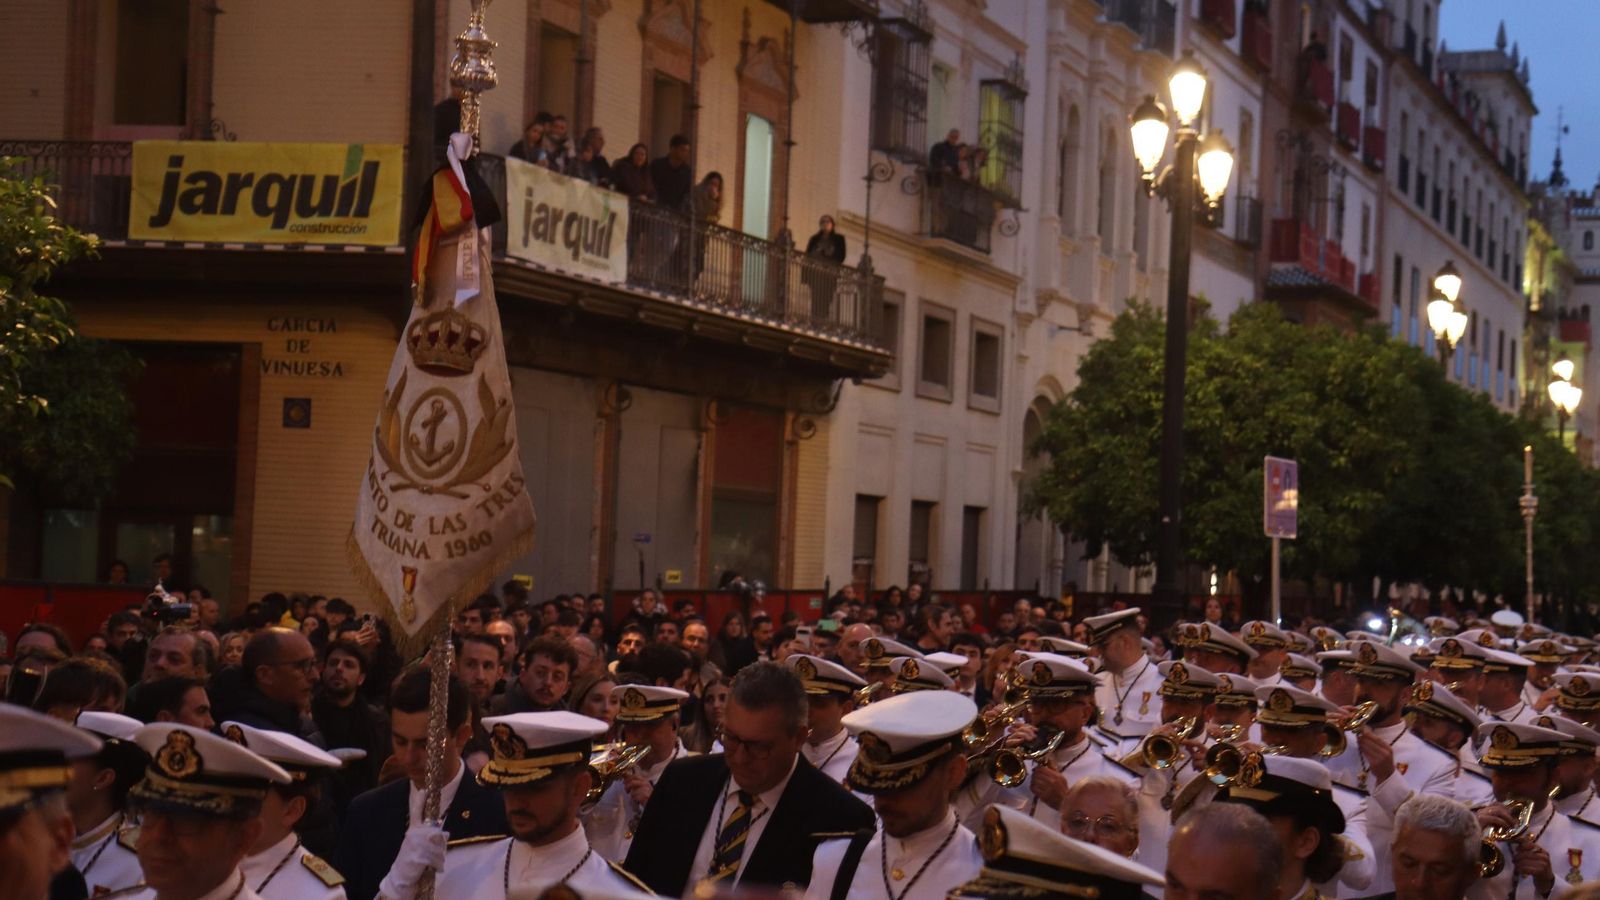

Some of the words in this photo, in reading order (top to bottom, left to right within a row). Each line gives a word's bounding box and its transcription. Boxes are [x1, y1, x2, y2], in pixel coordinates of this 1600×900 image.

[148, 144, 380, 230] jarquil
[289, 221, 367, 235] construcción
[522, 186, 617, 261] jarquil
[261, 360, 343, 377] VINUESA
[286, 339, 311, 353] DE
[393, 509, 416, 533] DE
[429, 513, 467, 536] LAS
[476, 471, 525, 519] TRES
[371, 515, 431, 560] TRIANA
